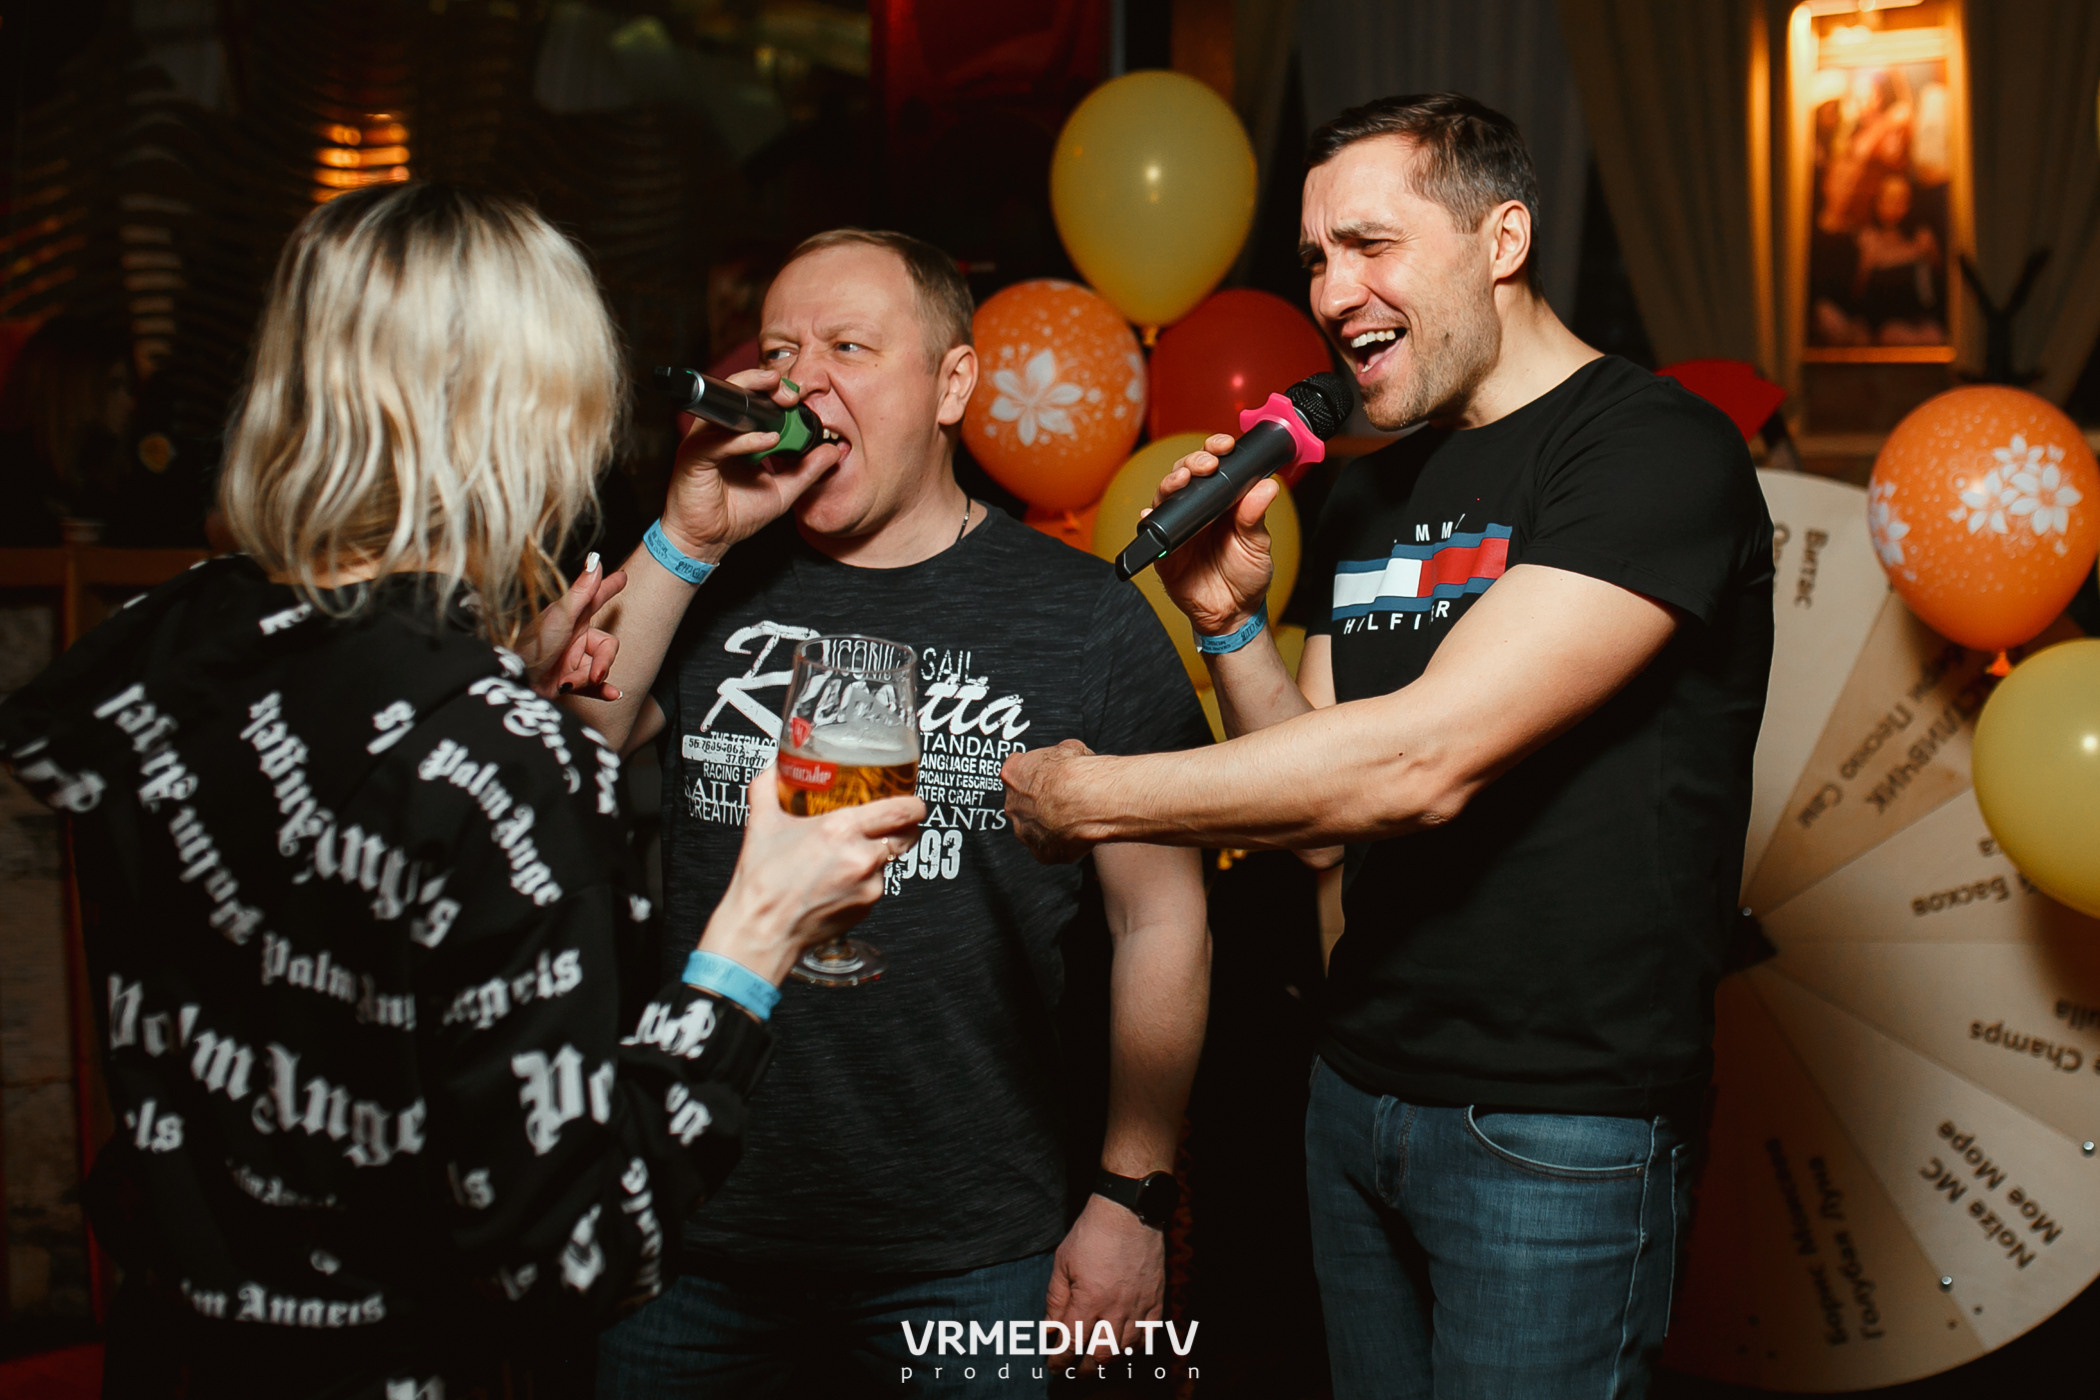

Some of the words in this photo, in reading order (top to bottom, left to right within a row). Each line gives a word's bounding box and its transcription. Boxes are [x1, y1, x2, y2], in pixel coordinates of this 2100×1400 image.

[703, 762, 740, 782] RACING
[917, 752, 978, 773] ANGUAGE
[915, 785, 946, 803] ATER
[948, 789, 985, 806] CRAFT
[1967, 1019, 2083, 1074] Champs
[1918, 1156, 1968, 1204] MC
[1936, 1119, 2008, 1191] Море
[1967, 1198, 2037, 1271] Noize
[2006, 1185, 2064, 1246] Мое
